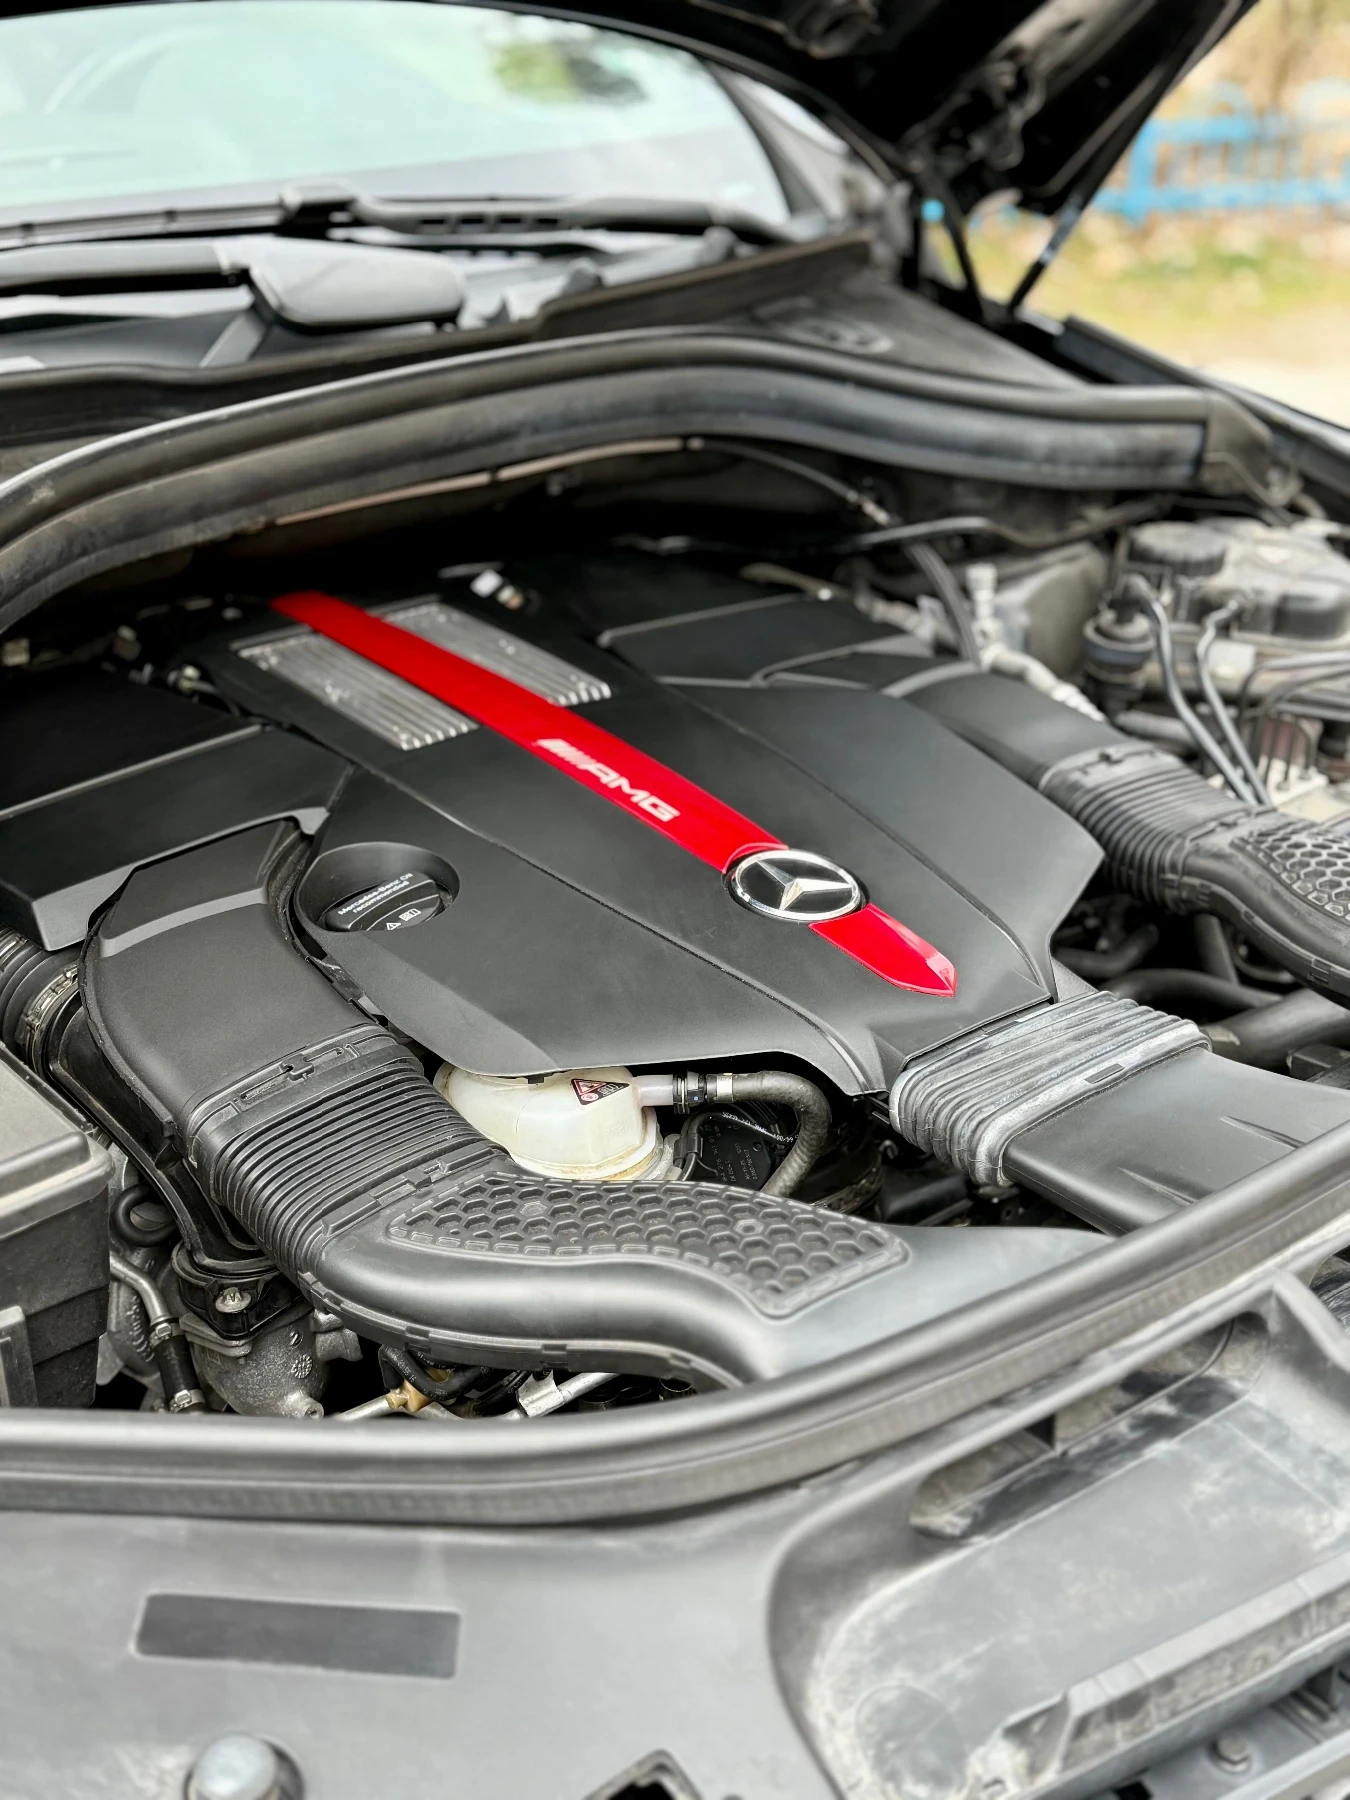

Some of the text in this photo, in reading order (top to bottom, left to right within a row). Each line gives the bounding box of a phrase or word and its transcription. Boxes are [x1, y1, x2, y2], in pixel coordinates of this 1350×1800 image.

[573, 762, 680, 822] AMG
[338, 873, 413, 915] Mercedes-Benz Oil
[353, 881, 409, 913] recommended
